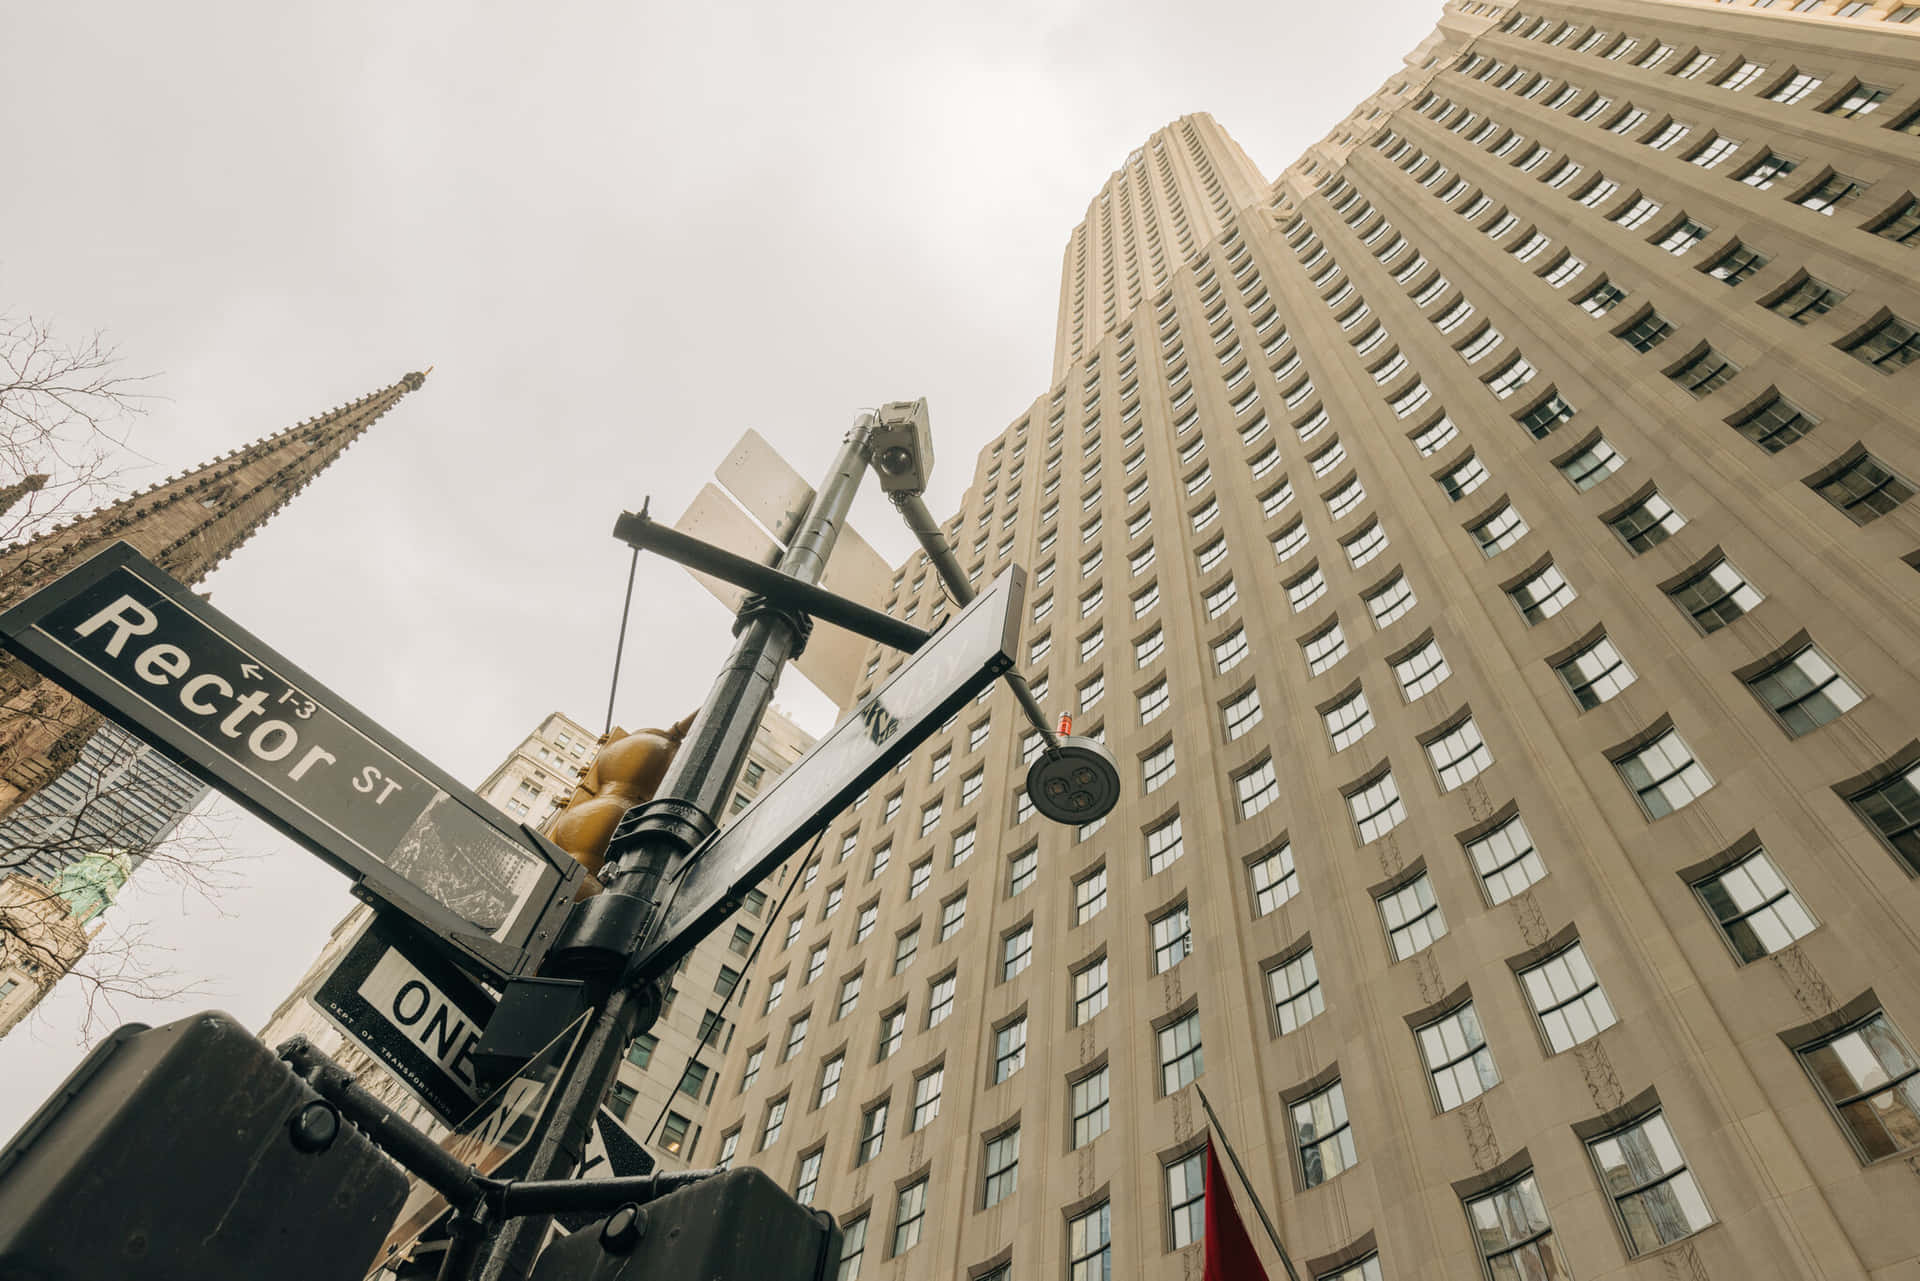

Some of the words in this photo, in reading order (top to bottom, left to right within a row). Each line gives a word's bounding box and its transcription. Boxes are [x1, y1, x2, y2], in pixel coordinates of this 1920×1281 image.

[73, 594, 336, 782] Rector
[352, 766, 403, 805] ST
[278, 688, 317, 719] 1-3
[329, 1002, 355, 1023] DEPT
[361, 1029, 375, 1040] OF
[381, 1046, 452, 1115] TRANSPORTATION
[393, 980, 480, 1088] ONE
